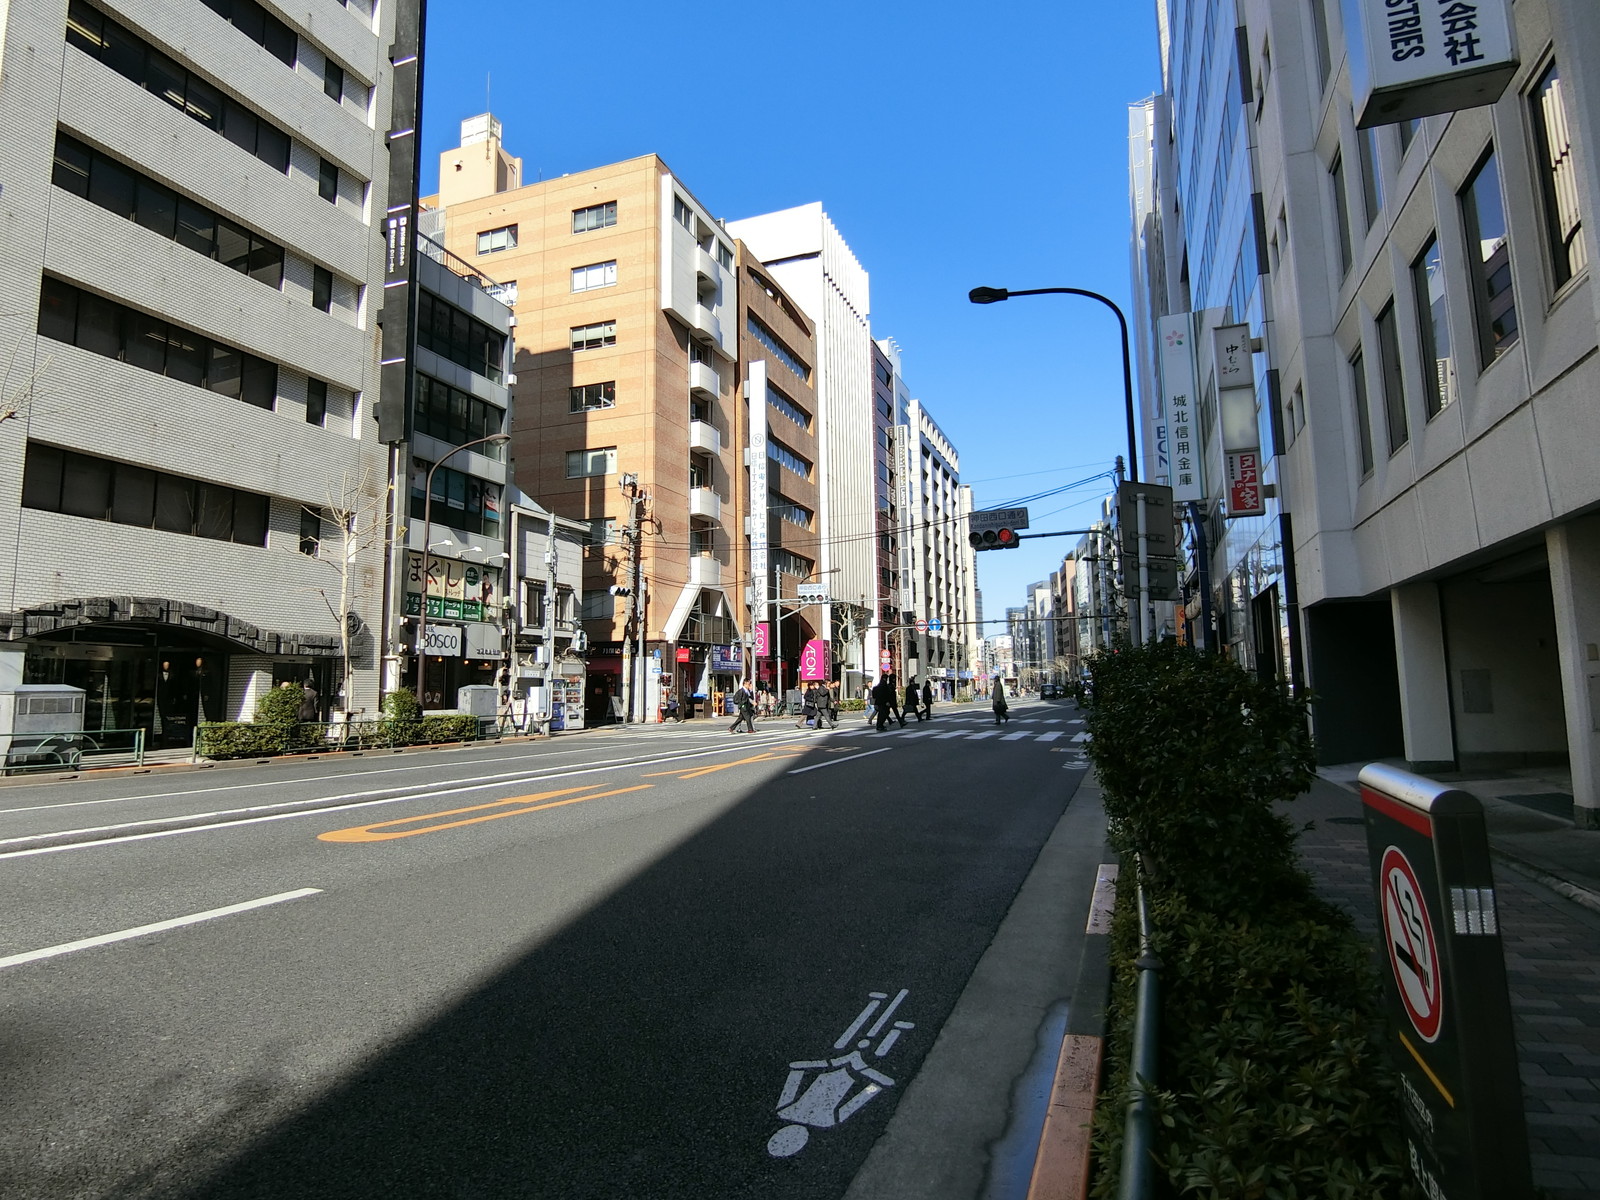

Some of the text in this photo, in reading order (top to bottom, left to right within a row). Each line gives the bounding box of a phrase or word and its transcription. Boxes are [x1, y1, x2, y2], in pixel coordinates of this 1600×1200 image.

[1438, 0, 1485, 66] 会社
[1172, 394, 1193, 487] 城北信用金庫
[971, 510, 1025, 522] 神田西口通り
[424, 633, 458, 649] BOSCO
